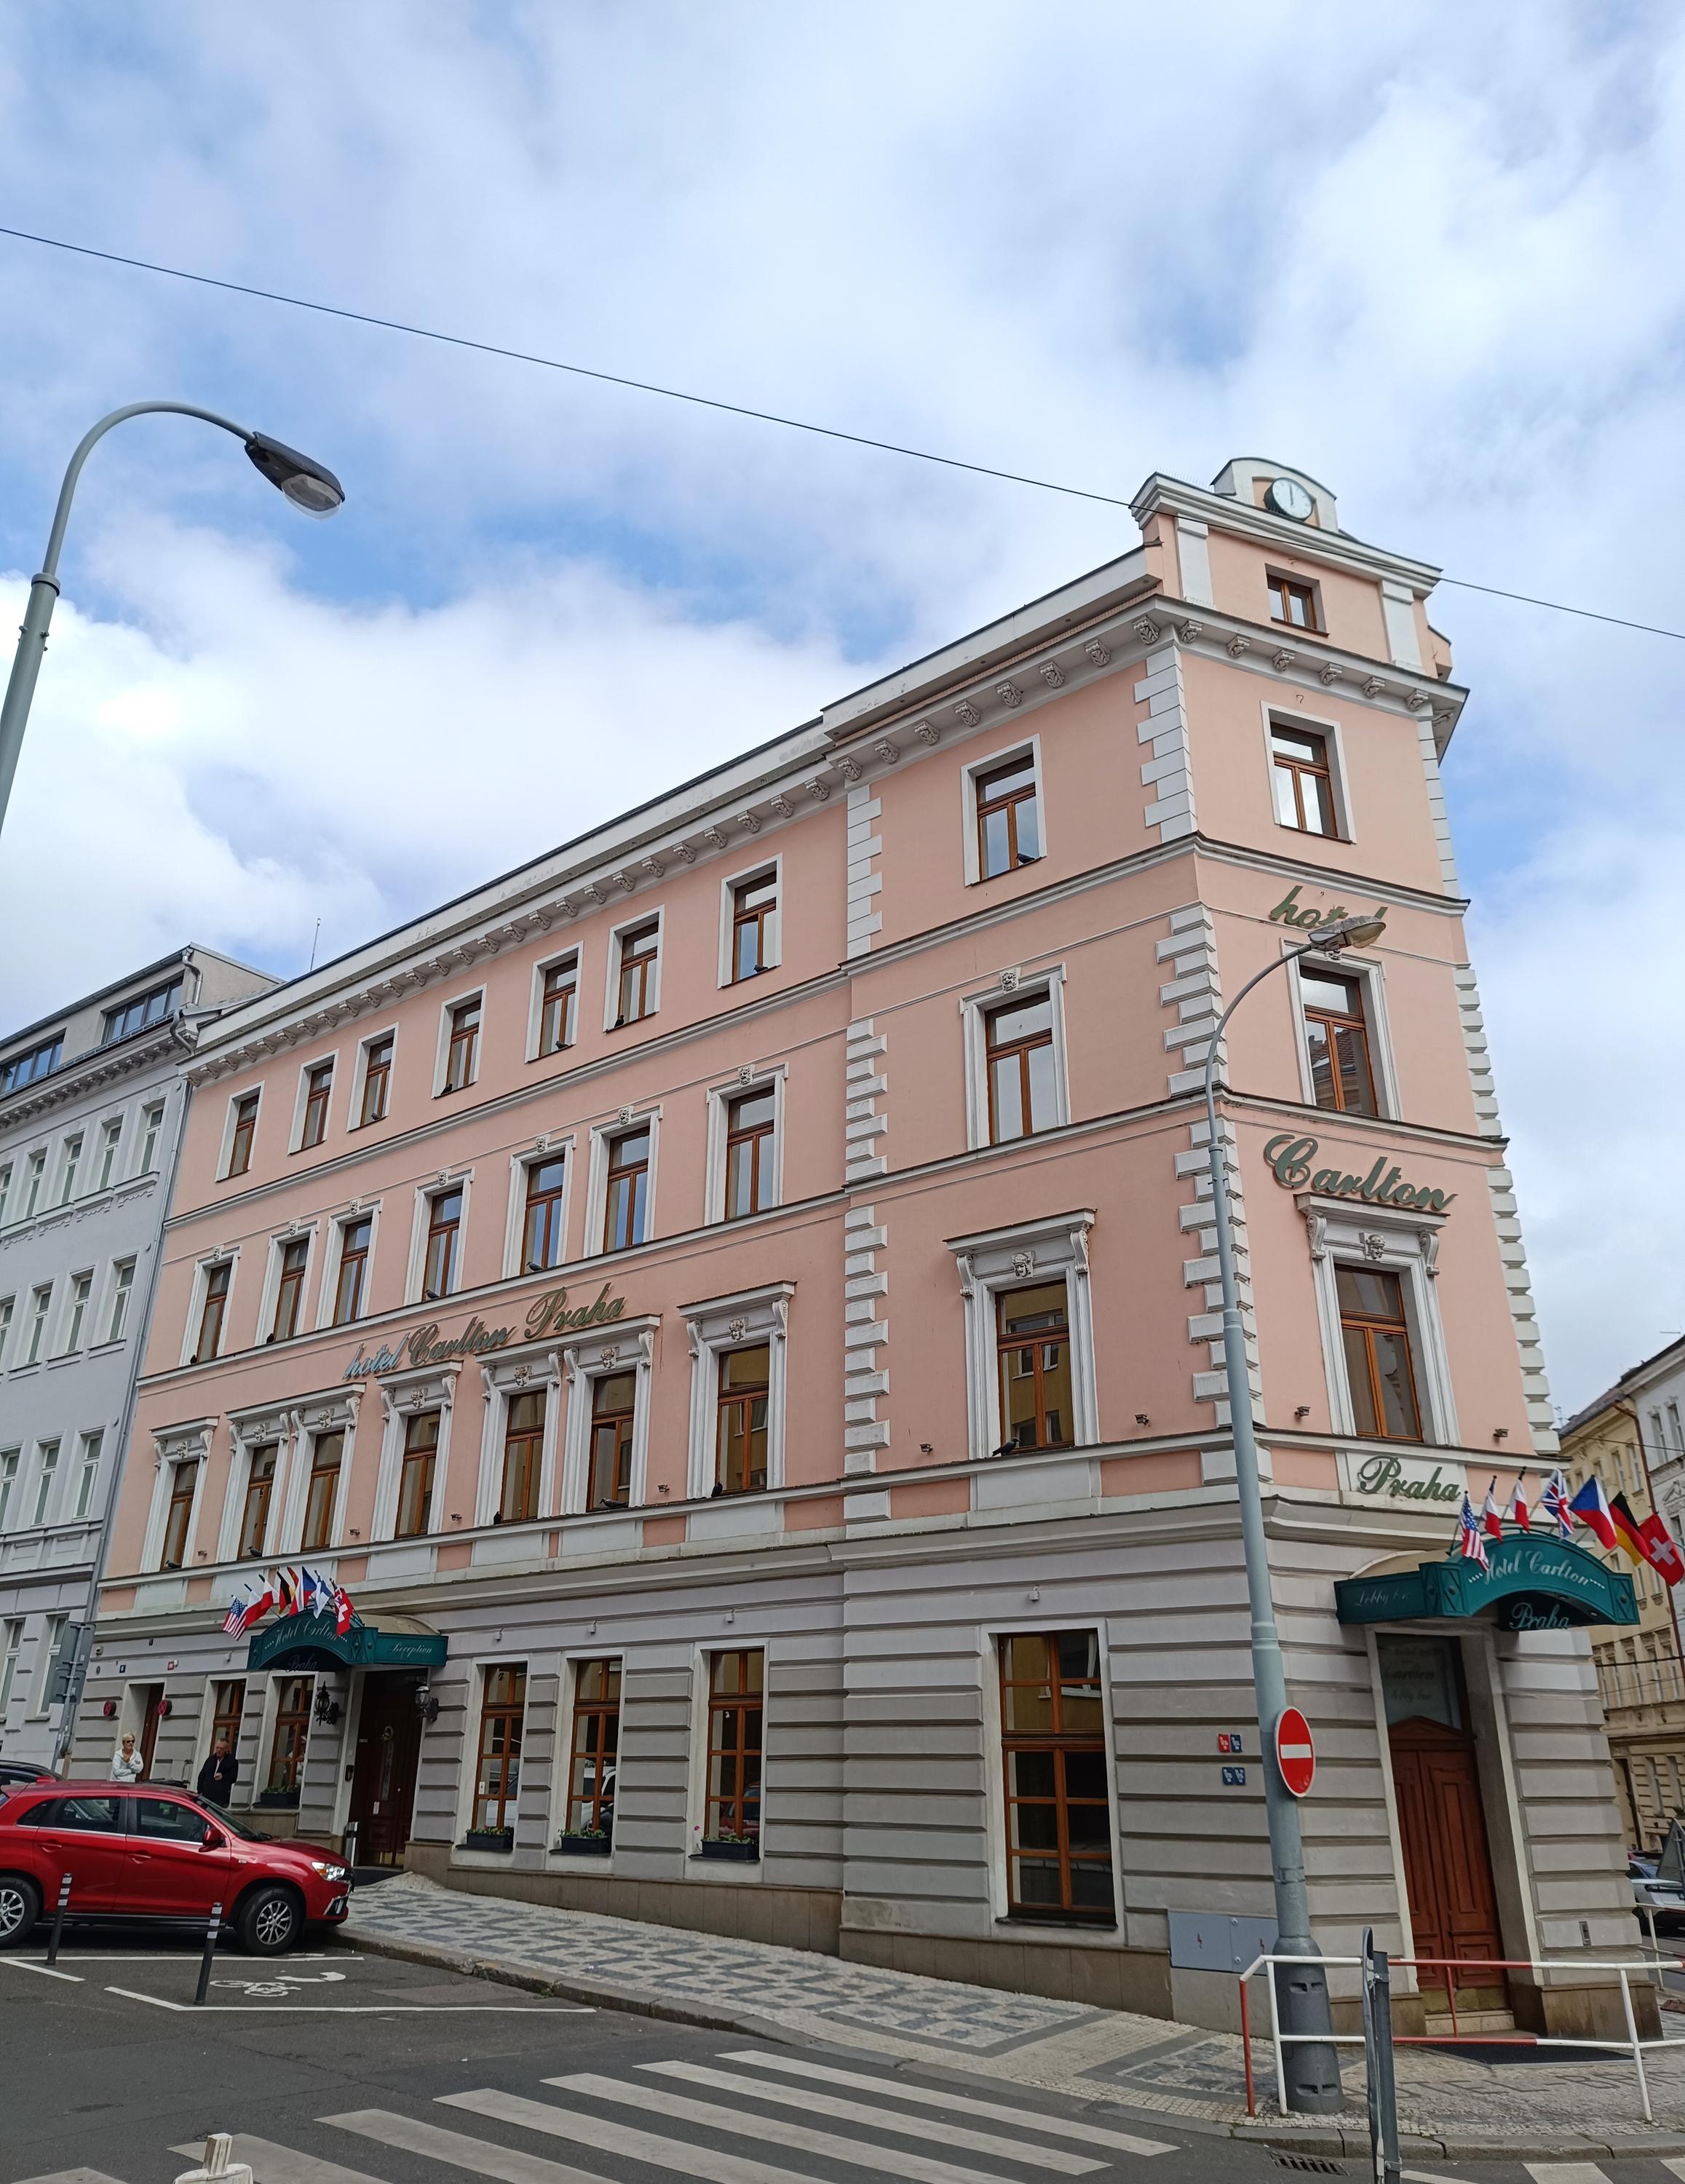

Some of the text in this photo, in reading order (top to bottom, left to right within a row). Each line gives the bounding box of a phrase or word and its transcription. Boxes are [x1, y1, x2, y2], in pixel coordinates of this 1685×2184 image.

[1269, 885, 1389, 928] hot
[1264, 1134, 1458, 1211] Carlton
[342, 1283, 627, 1380] hotel Carlton Praha
[1357, 1455, 1462, 1502] Praha
[1484, 1549, 1590, 1586] Hotel Carlton
[274, 1618, 301, 1649] Hotel
[1509, 1602, 1571, 1630] Praha
[392, 1642, 433, 1658] Reception
